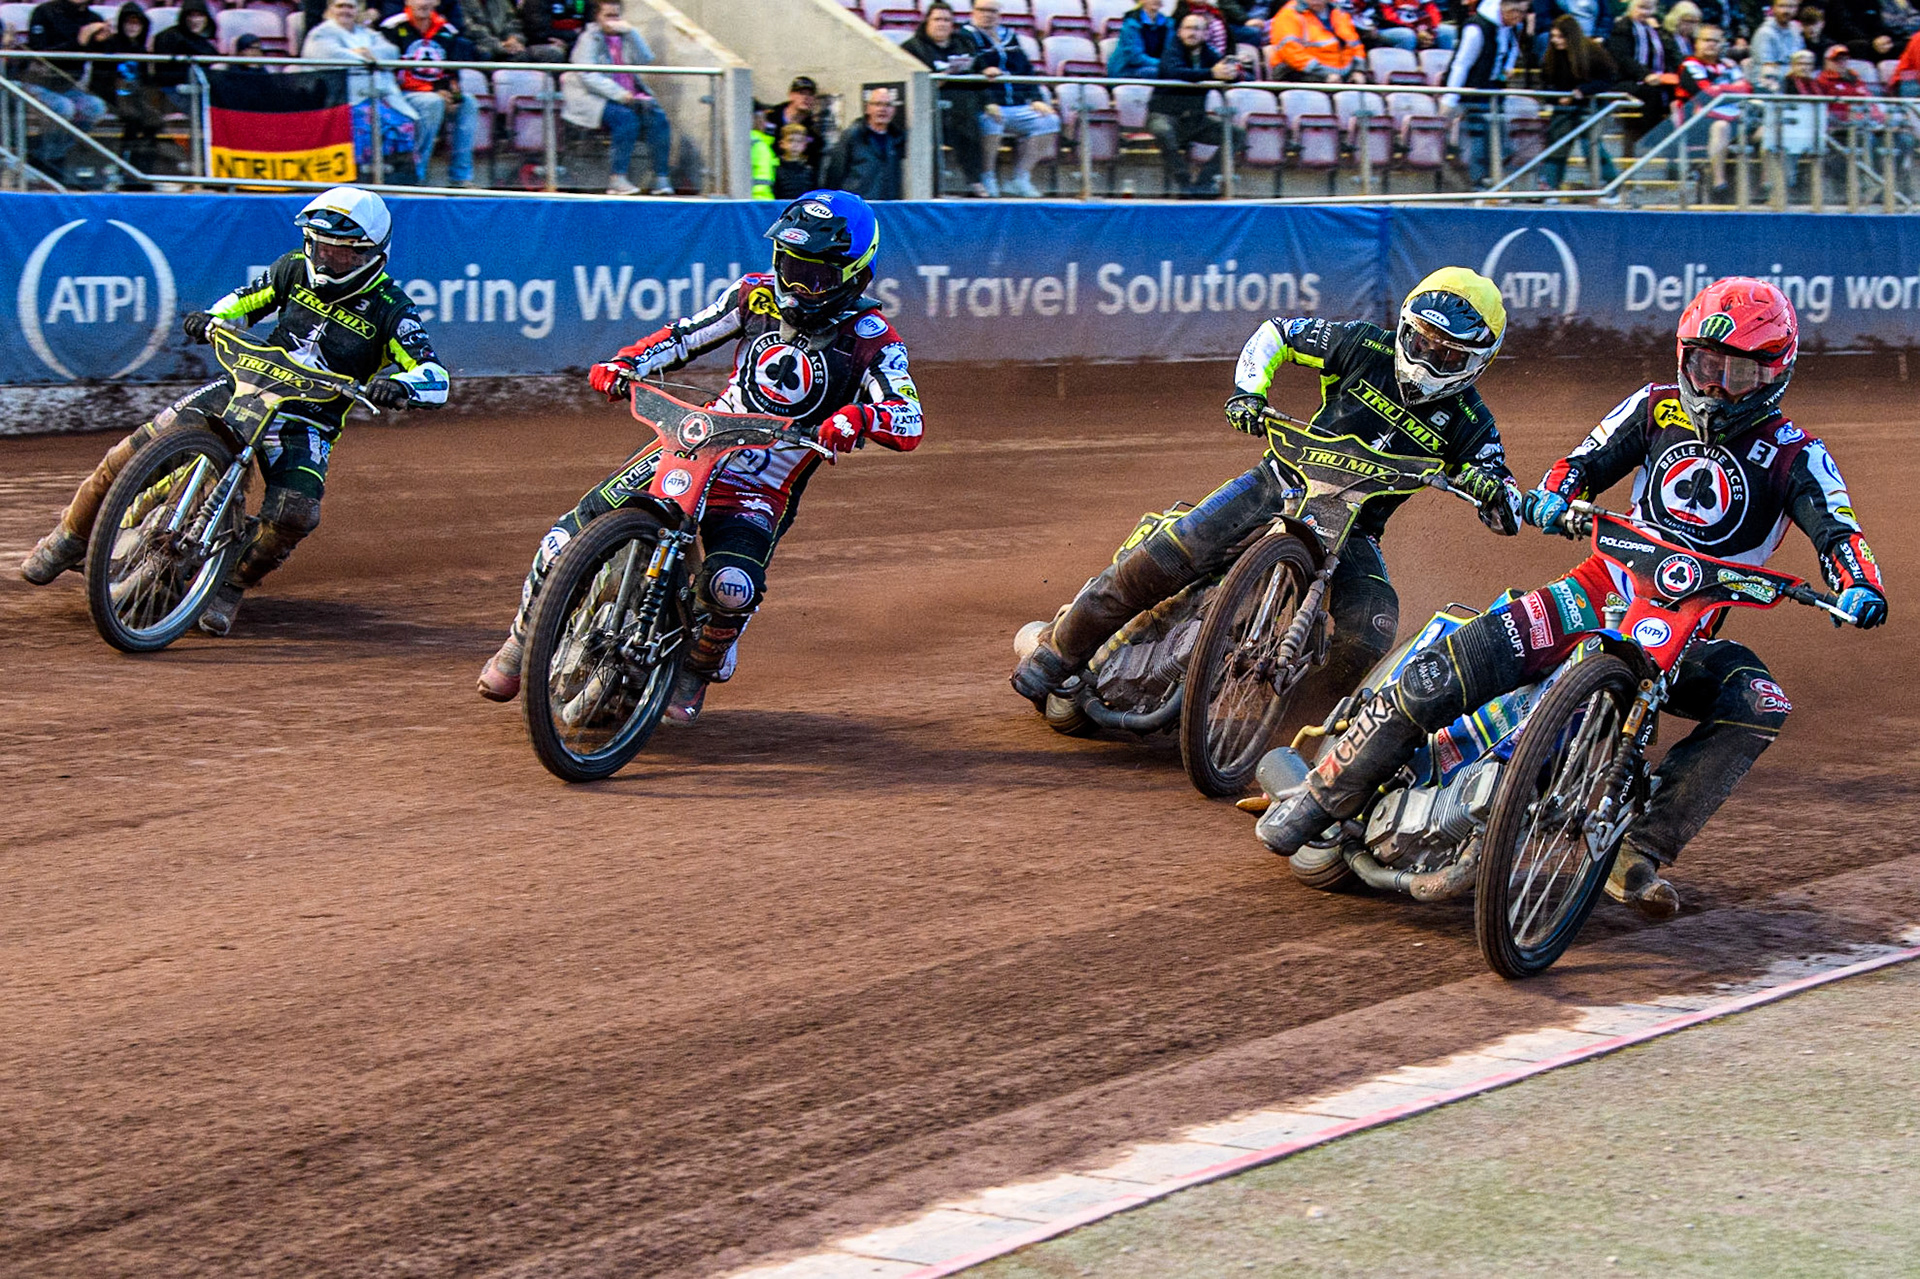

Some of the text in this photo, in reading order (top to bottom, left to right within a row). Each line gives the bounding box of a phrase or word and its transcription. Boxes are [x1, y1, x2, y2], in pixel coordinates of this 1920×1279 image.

[46, 276, 147, 323] ATPI
[918, 262, 1078, 317] Travel
[1097, 259, 1321, 314] Solutions
[1501, 271, 1560, 308] ATPI
[1845, 275, 1920, 309] wor
[335, 308, 372, 334] MIX
[239, 354, 269, 372] TRU
[810, 355, 824, 384] ACES
[1362, 387, 1442, 451] TRU MIX
[1430, 410, 1450, 427] 6
[1306, 449, 1392, 483] TRU MIX
[1750, 441, 1771, 465] 3
[1660, 446, 1743, 500] BELLE VUE ACES
[1599, 535, 1656, 554] POLCOPPER
[716, 581, 747, 598] ATPI
[1500, 612, 1526, 658] DOCUFY
[1639, 625, 1664, 638] ATPI
